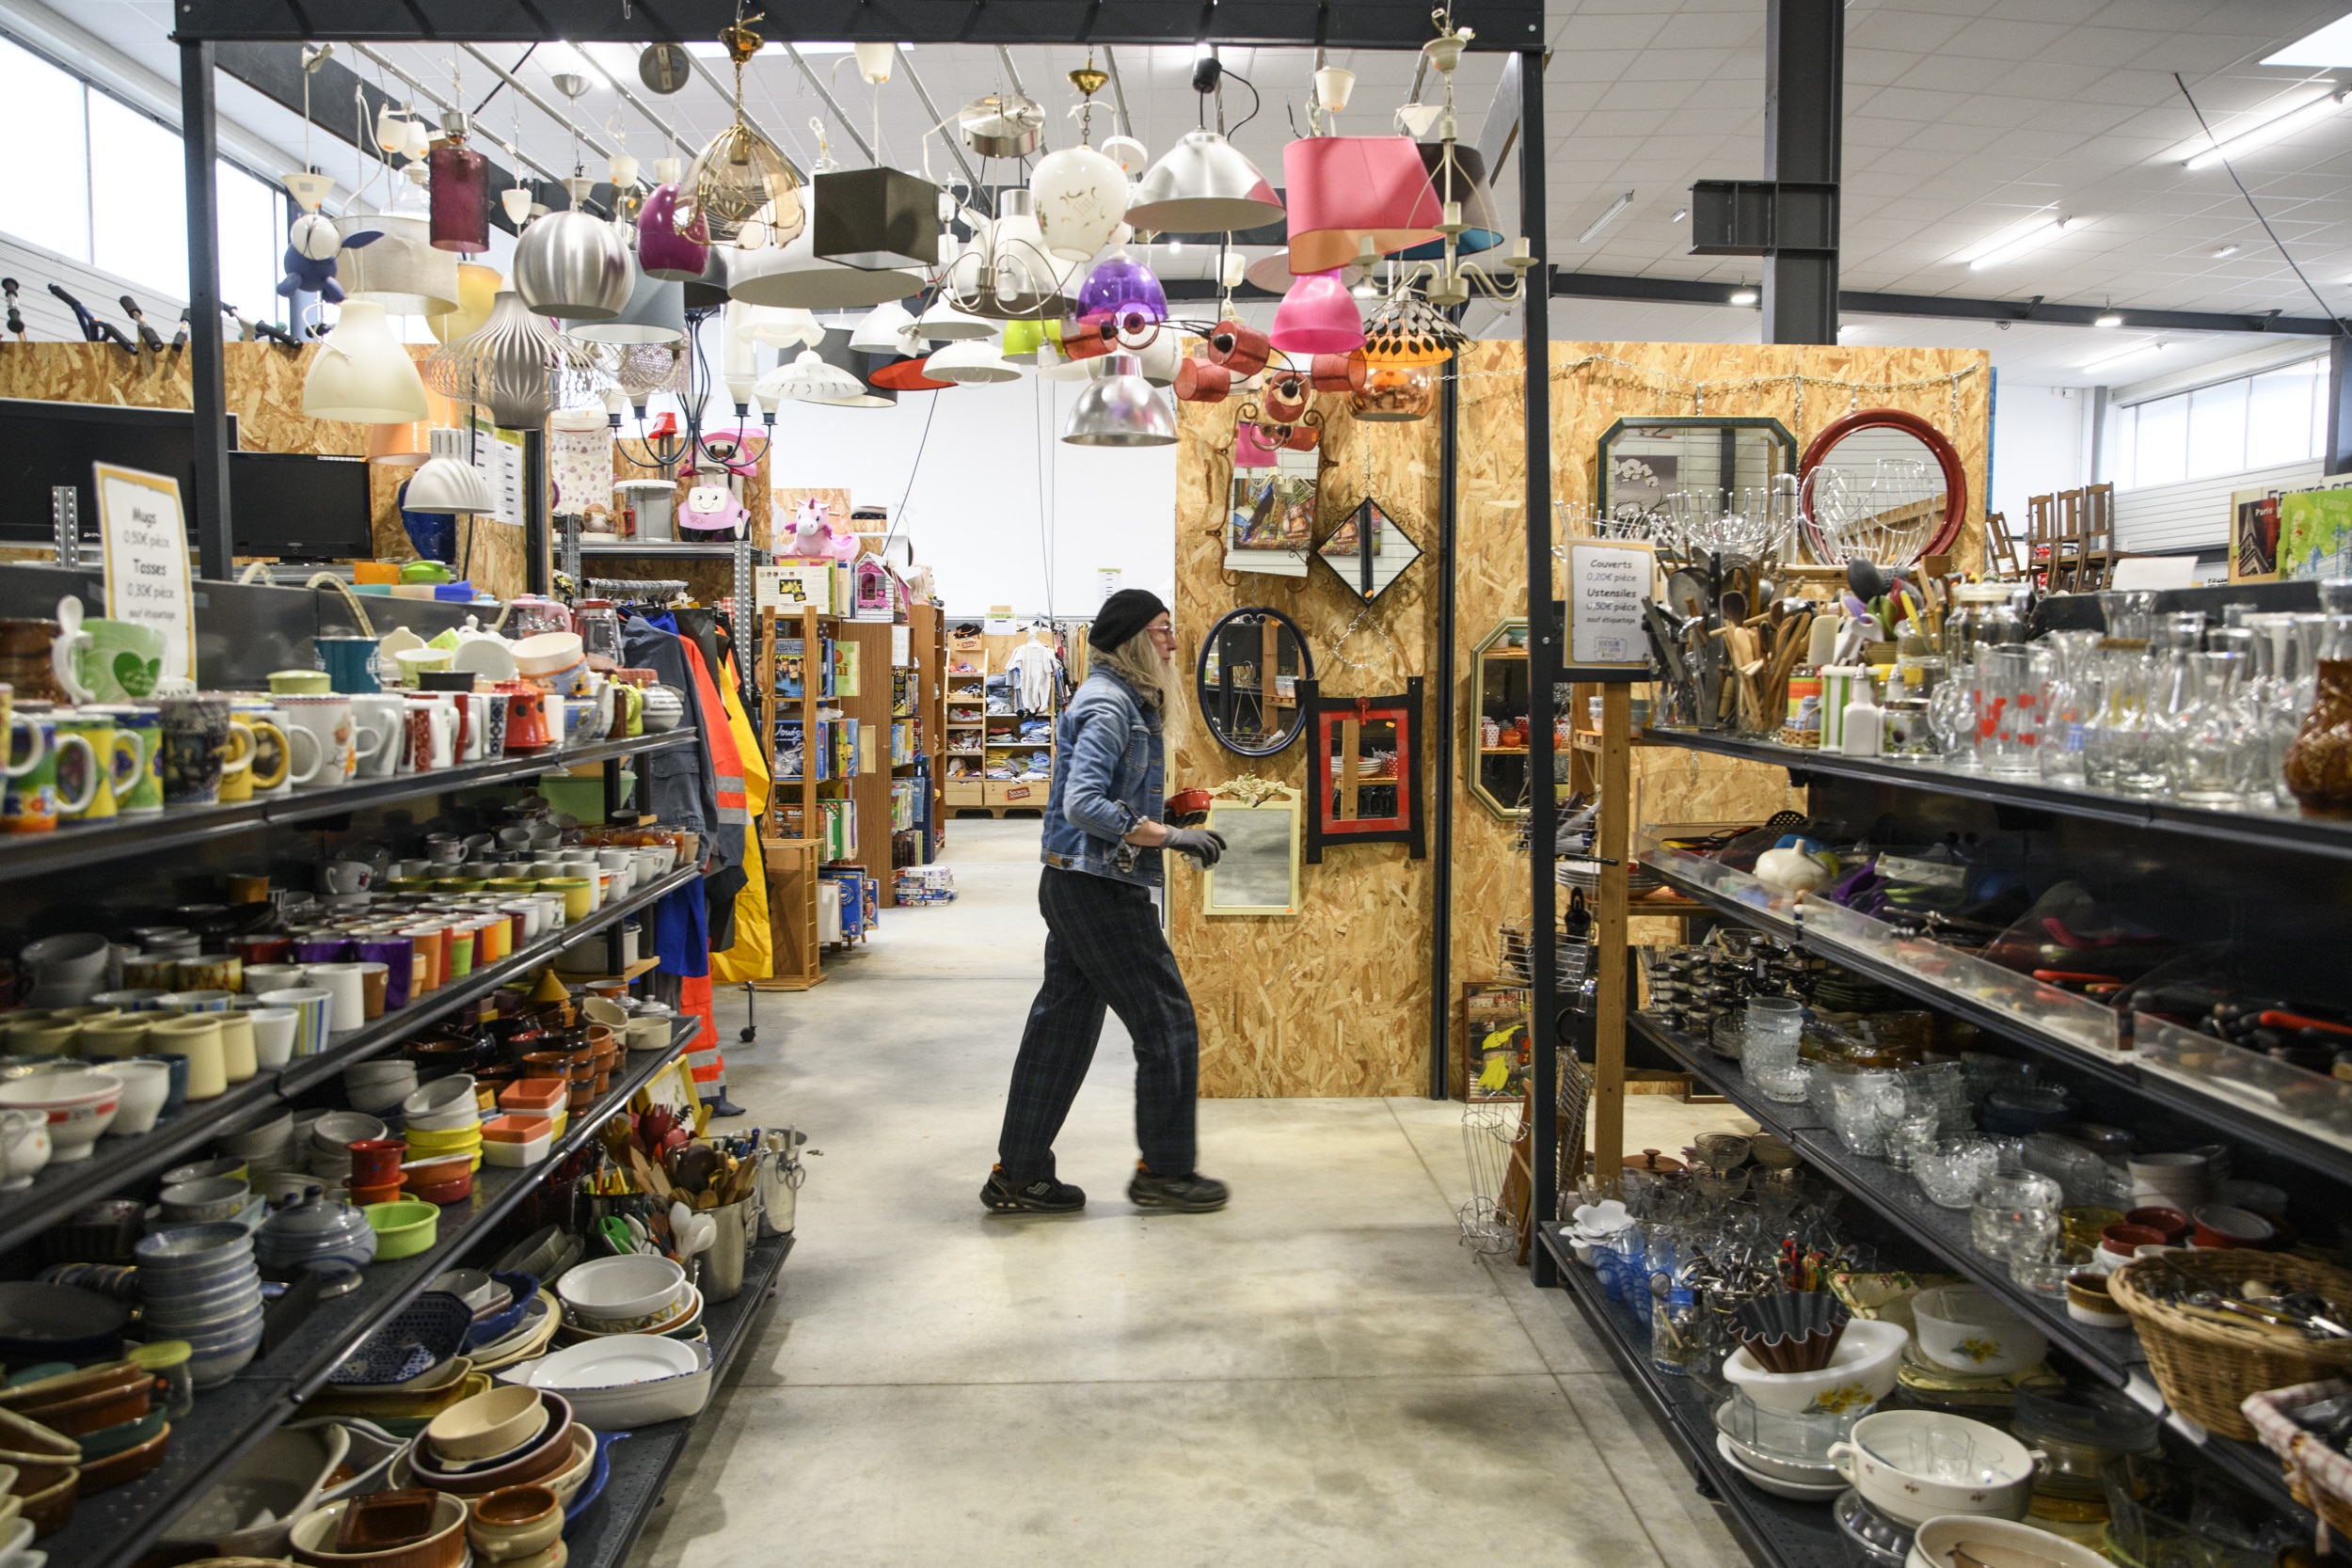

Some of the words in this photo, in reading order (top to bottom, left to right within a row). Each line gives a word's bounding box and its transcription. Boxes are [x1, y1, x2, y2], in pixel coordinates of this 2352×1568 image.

[2255, 507, 2274, 517] Paris
[133, 507, 157, 528] Mugs
[149, 534, 170, 549] pièce
[133, 559, 167, 576] Tasses
[1590, 560, 1633, 570] Couverts
[1586, 573, 1613, 582] 0,20€
[1613, 574, 1638, 583] pièce
[153, 587, 175, 601] pièce
[1587, 589, 1637, 598] Ustensiles
[1586, 602, 1613, 611] 0,50€
[1613, 603, 1638, 612] pièce
[1586, 616, 1601, 625] sauf
[1602, 617, 1636, 626] étiquetage
